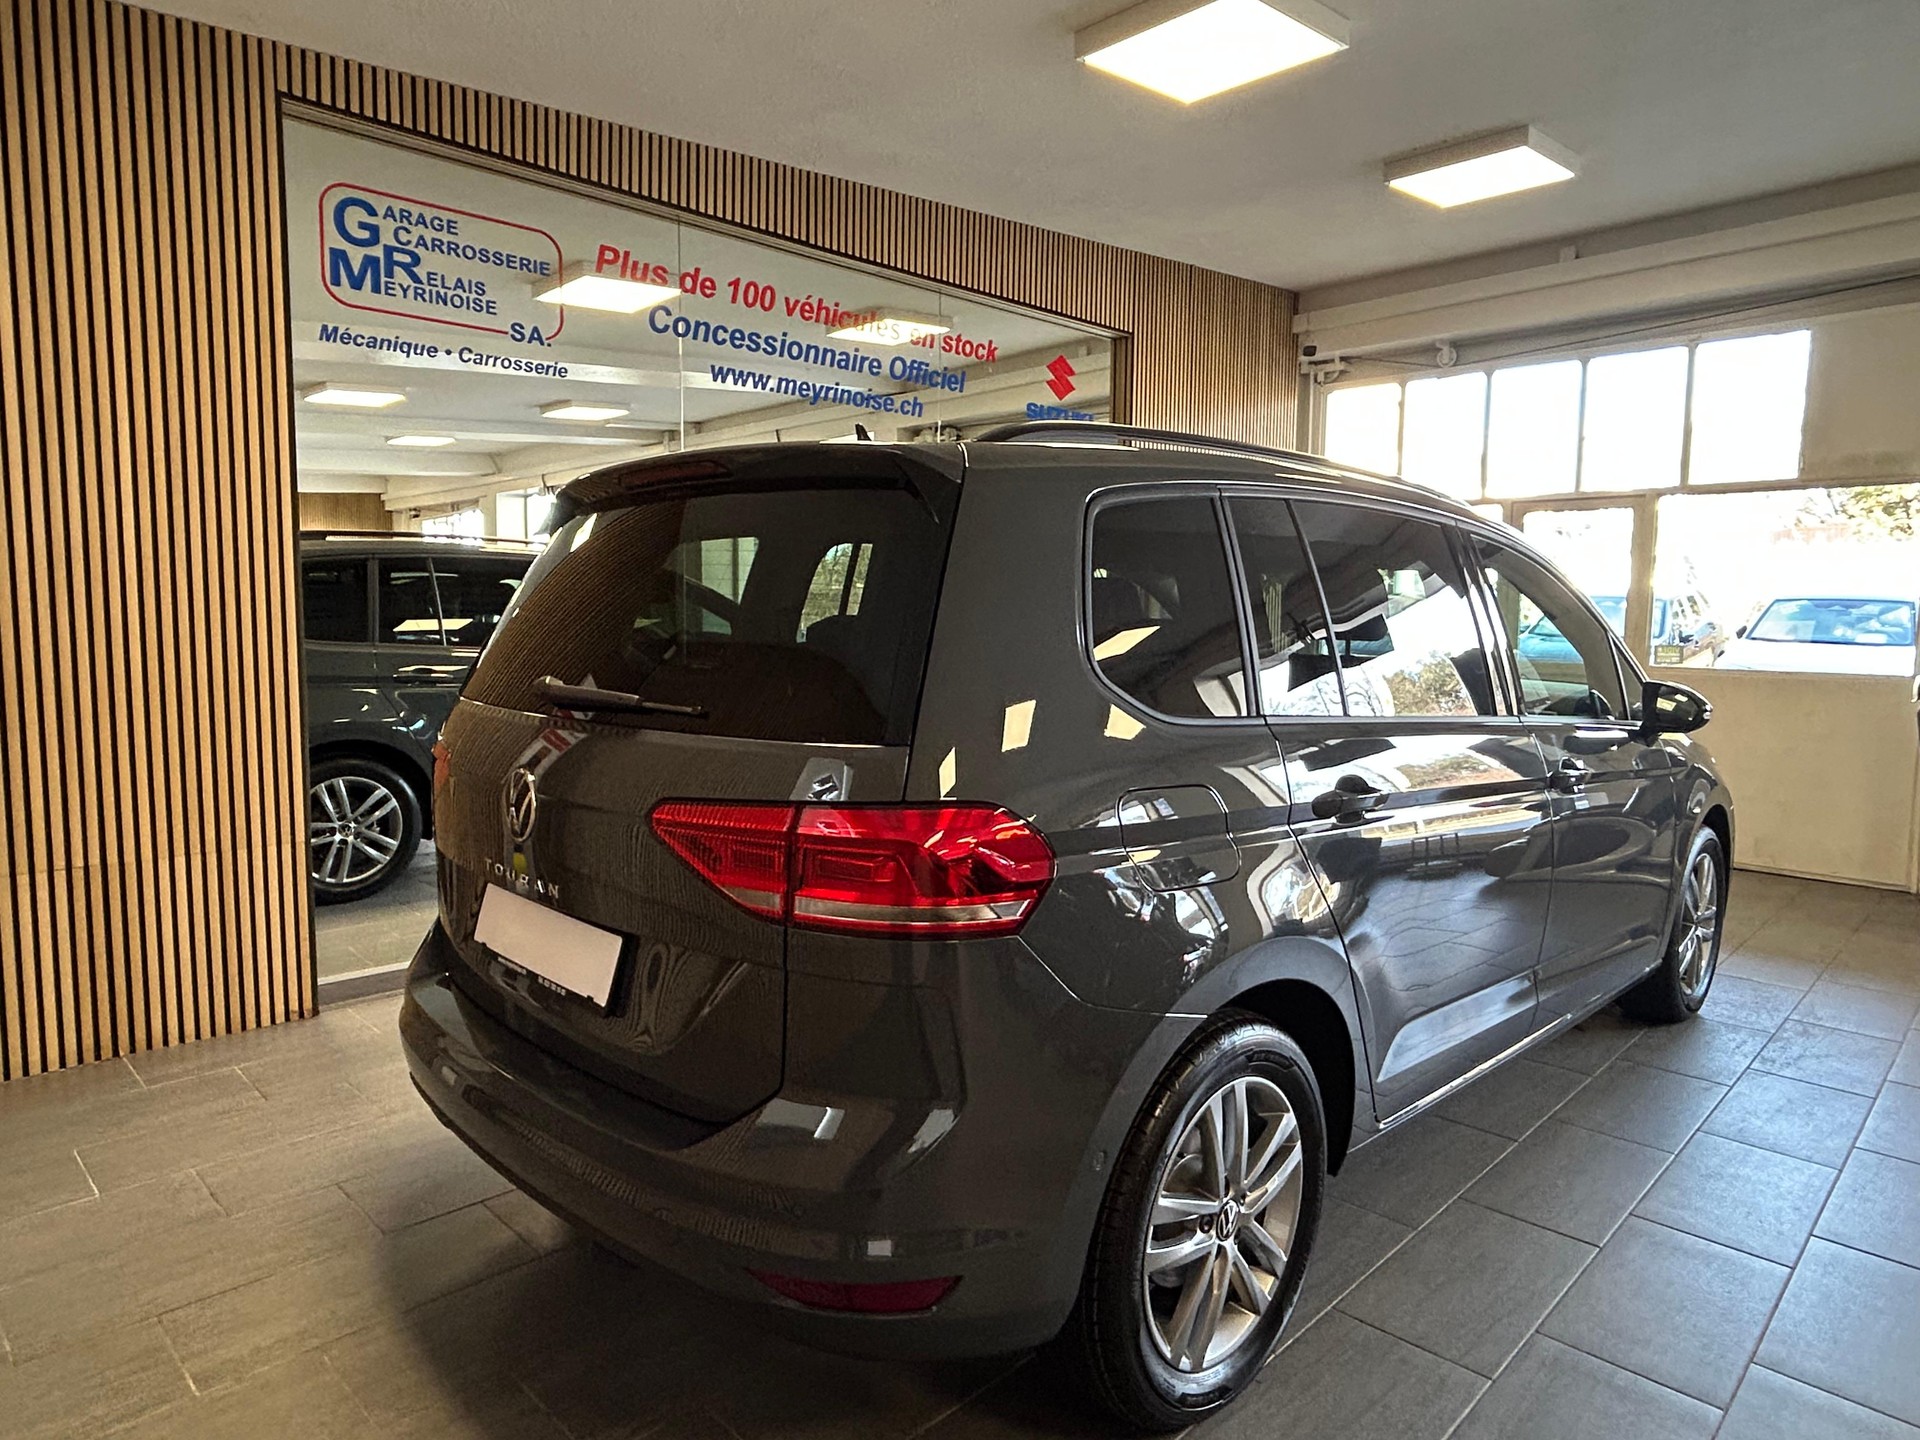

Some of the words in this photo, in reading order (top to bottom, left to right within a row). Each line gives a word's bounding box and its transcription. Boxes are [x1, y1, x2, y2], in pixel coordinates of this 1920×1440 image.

[383, 244, 486, 297] RELAIS
[393, 225, 551, 277] CARROSSERIE
[329, 246, 498, 315] MEYRINOISE
[595, 244, 669, 285] Plus
[679, 267, 717, 299] de
[727, 277, 776, 312] 100
[910, 328, 935, 349] en
[941, 333, 998, 363] stock
[319, 323, 439, 358] Mécanique
[458, 346, 568, 378] Carrosserie
[510, 322, 552, 347] SA.
[649, 305, 882, 376] Concessionnaire
[889, 356, 967, 393] Officiel
[710, 364, 924, 417] www.meyrinoise.ch
[485, 857, 560, 899] TOURAN
